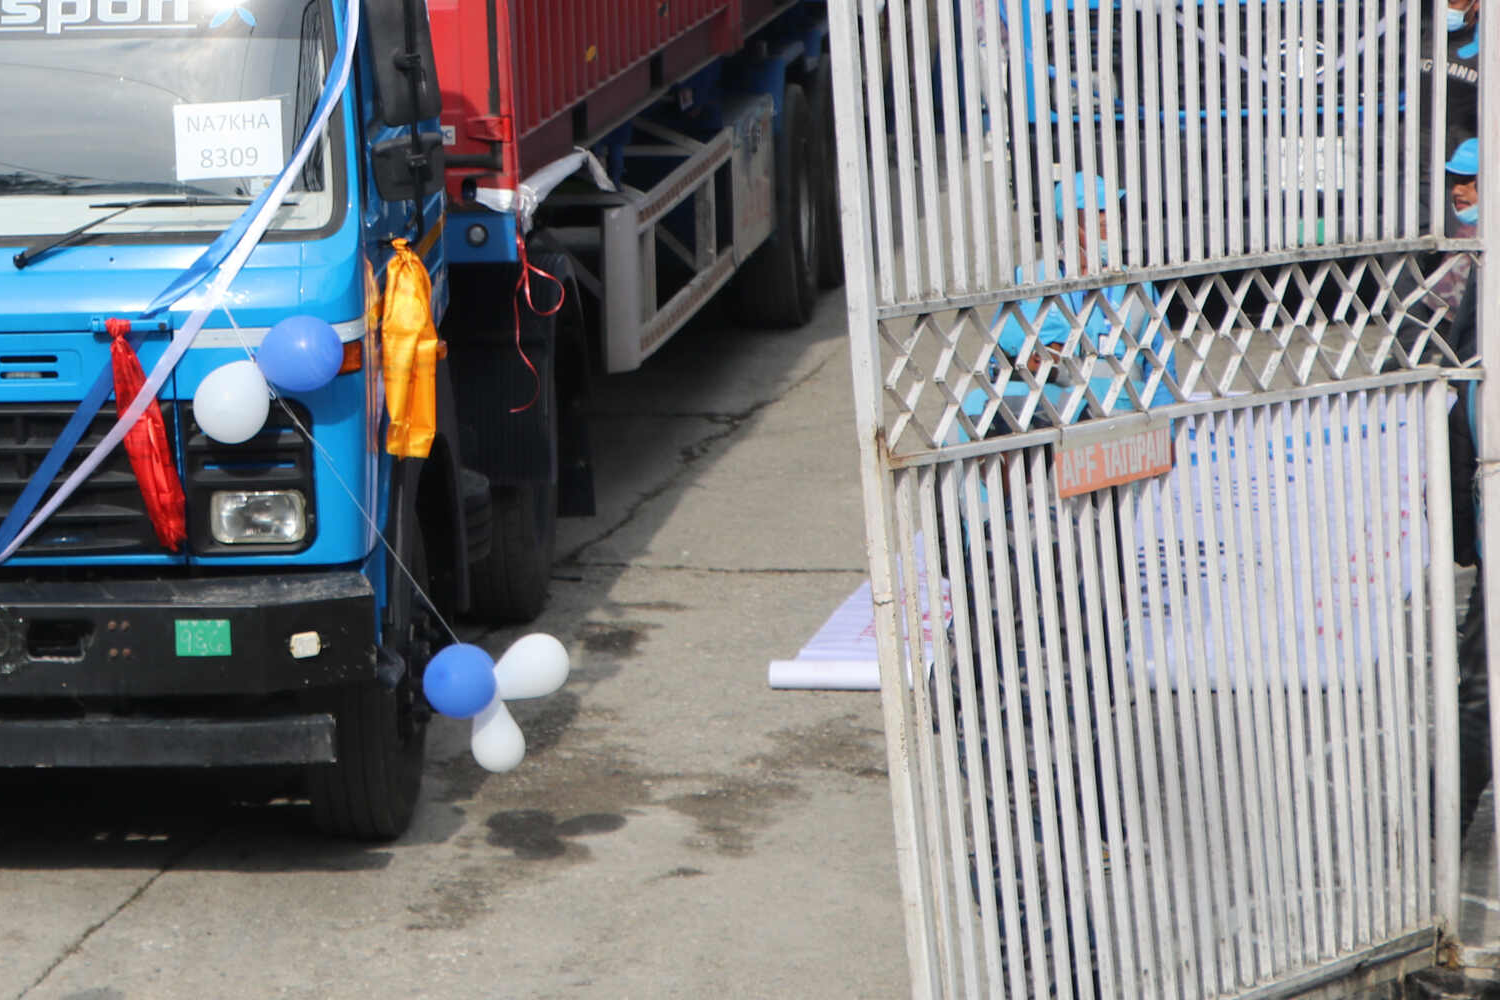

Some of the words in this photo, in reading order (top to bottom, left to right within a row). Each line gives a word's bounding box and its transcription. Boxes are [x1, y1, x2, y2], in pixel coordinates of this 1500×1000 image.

[187, 113, 270, 133] NA7KHA
[200, 146, 259, 168] 8309
[1061, 446, 1097, 489] APF
